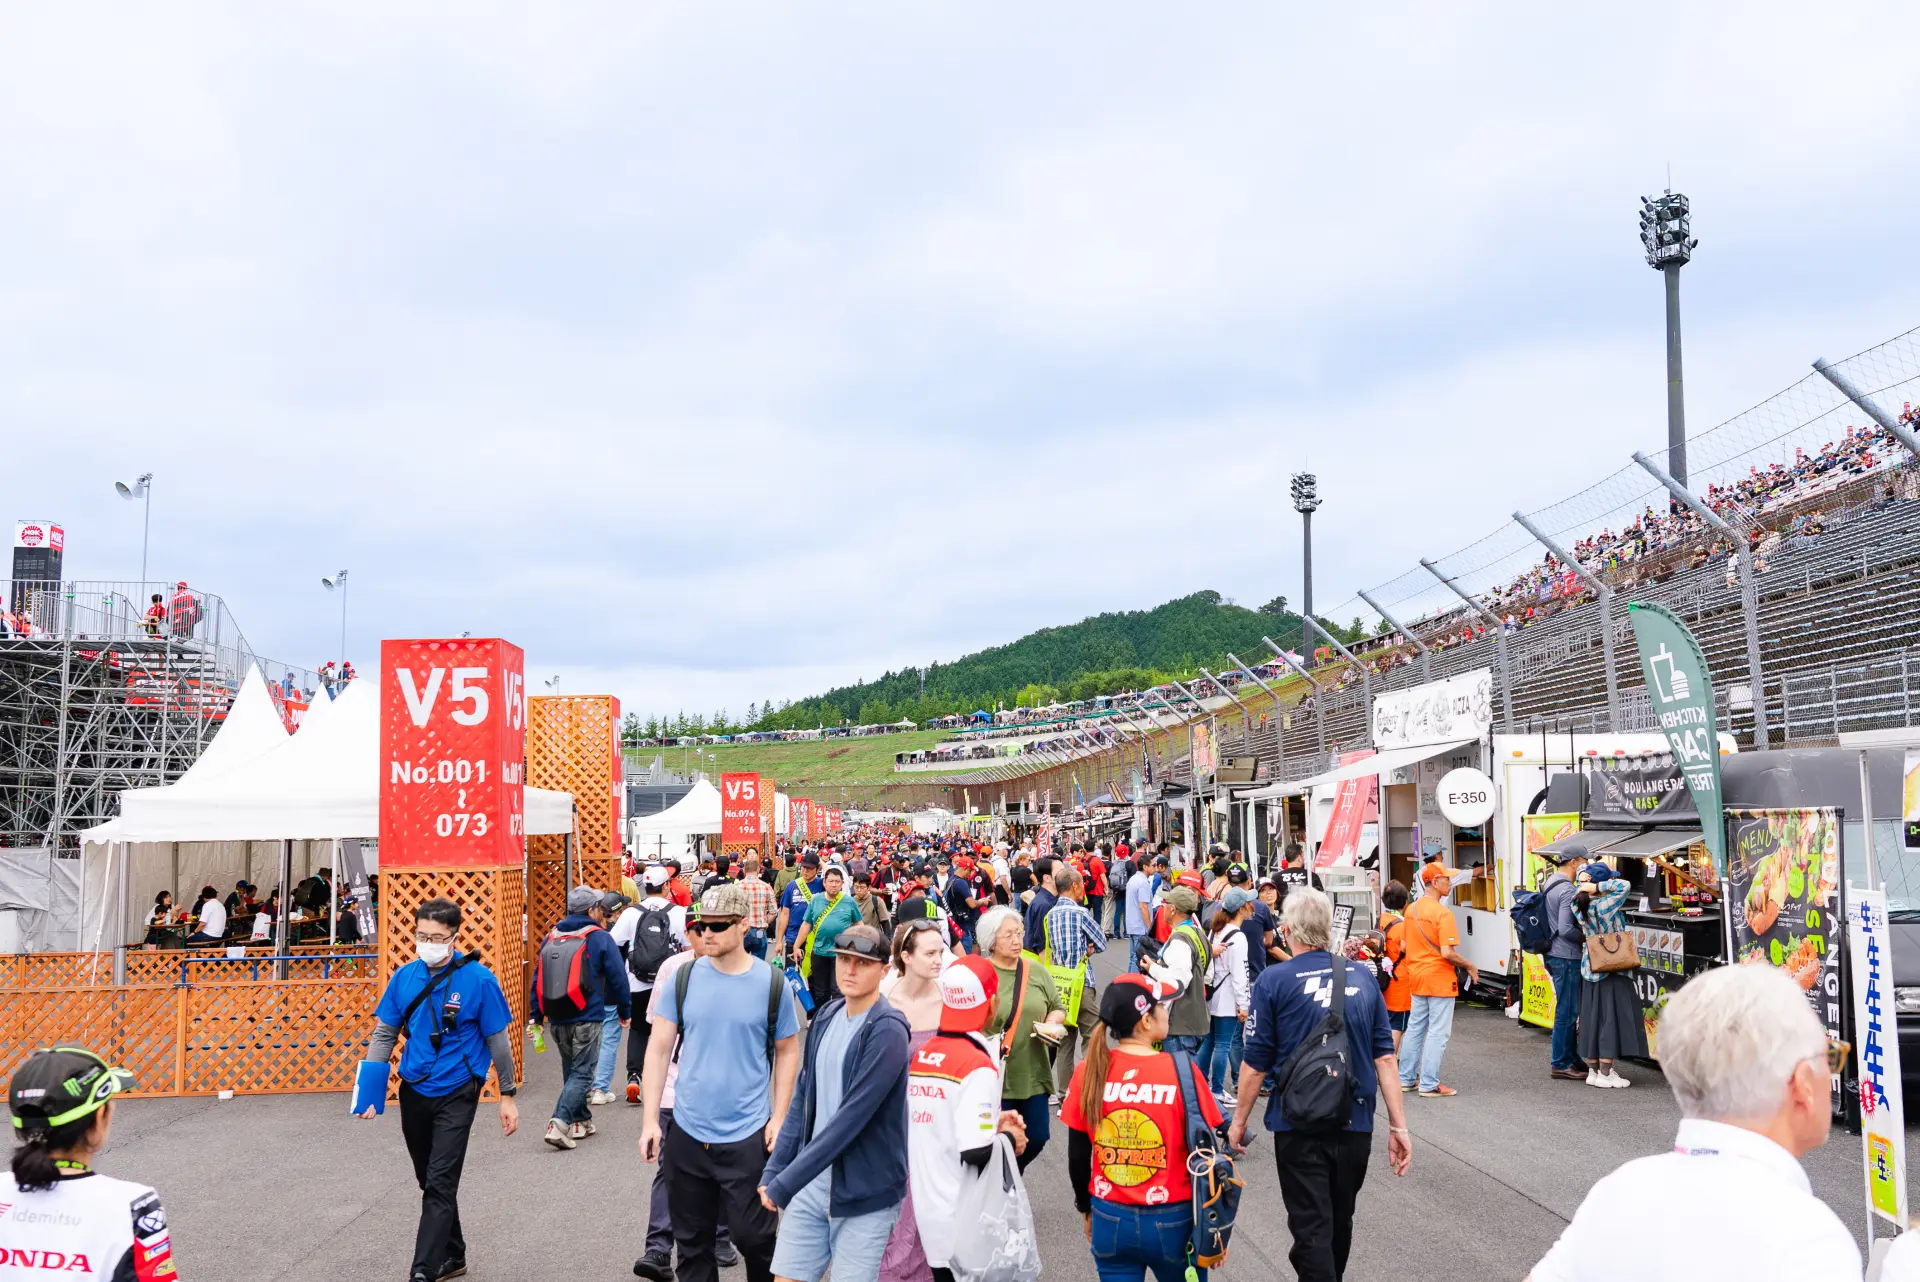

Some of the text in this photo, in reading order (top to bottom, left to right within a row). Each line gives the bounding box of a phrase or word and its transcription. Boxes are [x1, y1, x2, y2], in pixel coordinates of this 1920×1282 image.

[396, 667, 489, 726] V5
[503, 668, 523, 731] V5
[1452, 695, 1471, 716] PIZZA
[391, 760, 486, 784] No.001
[725, 780, 755, 800] V5
[1624, 777, 1684, 794] BOULANGERIE
[1449, 791, 1487, 805] E-350
[1636, 796, 1659, 809] RASE
[436, 813, 488, 837] 073
[739, 826, 755, 834] 196
[1740, 828, 1773, 858] MENU
[1805, 853, 1825, 955] RASE
[1103, 1082, 1177, 1105] UCATI
[1116, 1148, 1167, 1168] FREE
[12, 1206, 82, 1227] idemitsu
